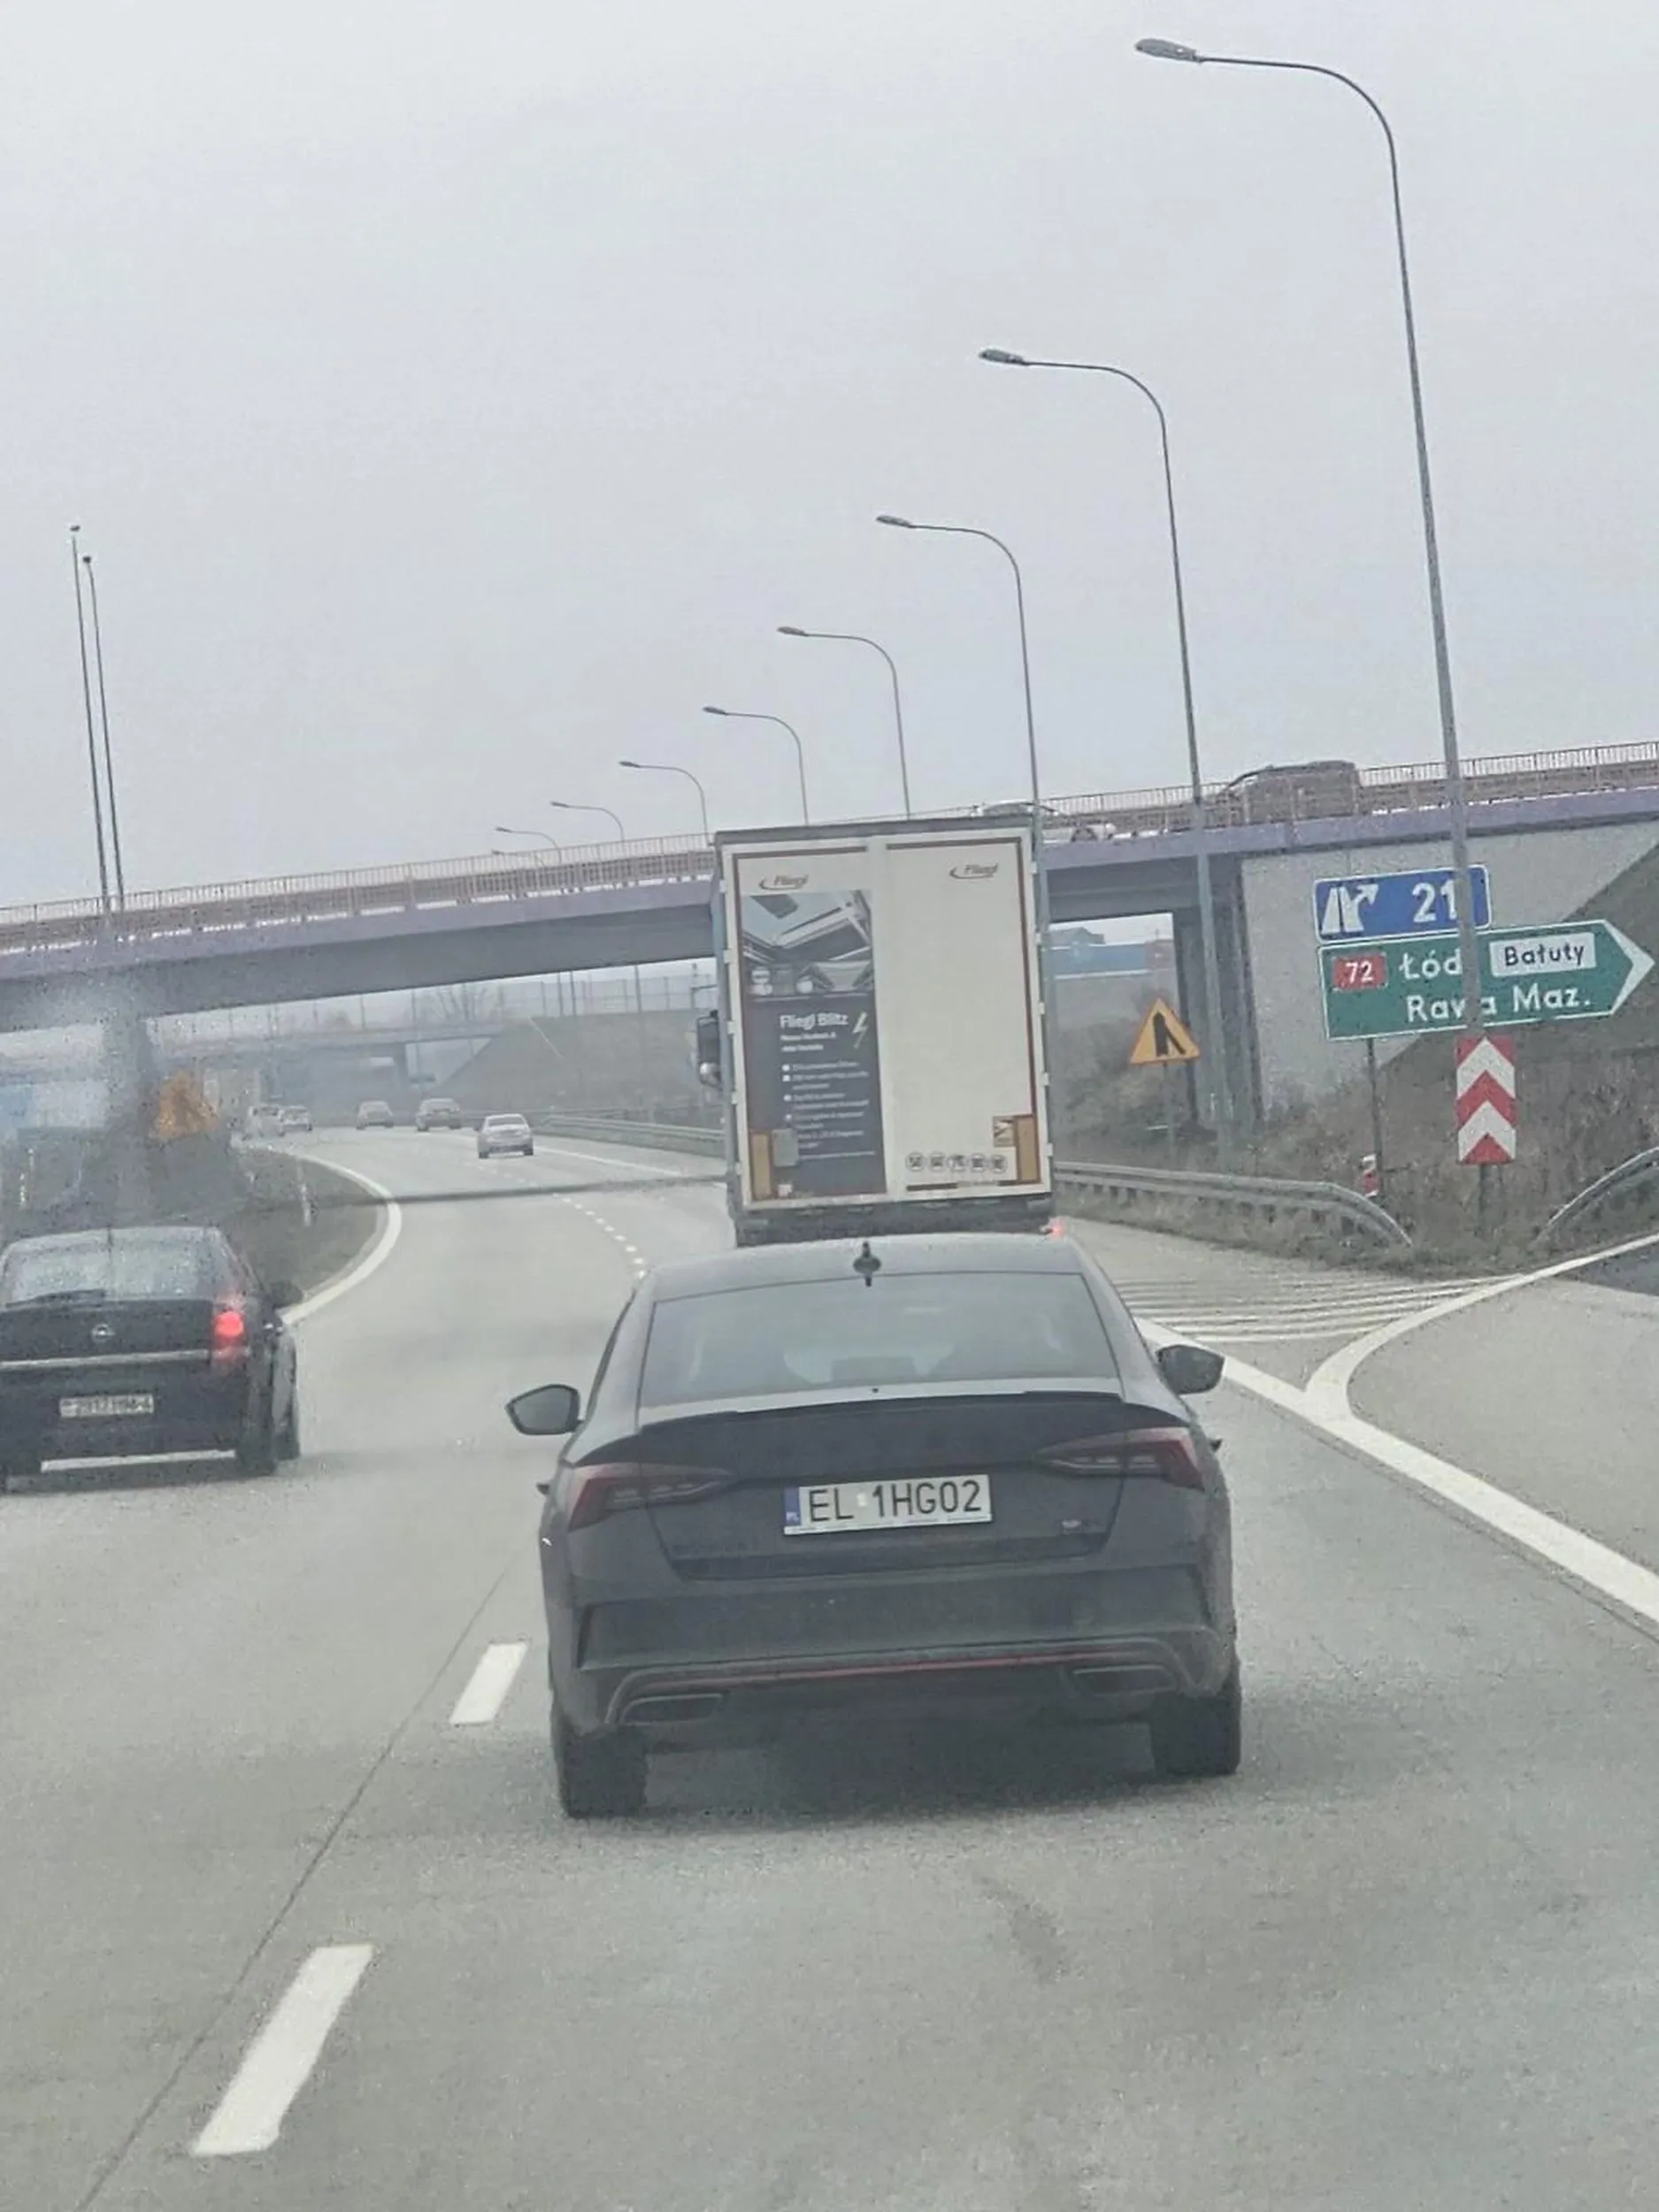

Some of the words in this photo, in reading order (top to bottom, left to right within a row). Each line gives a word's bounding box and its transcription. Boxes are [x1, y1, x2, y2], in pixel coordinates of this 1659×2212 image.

[1412, 879, 1457, 923] 21
[1398, 948, 1463, 979] Łód
[1504, 944, 1586, 967] Bałuty
[1345, 960, 1374, 984] 72
[1512, 982, 1591, 1013] Maz.
[809, 1488, 854, 1522] EL
[872, 1480, 981, 1519] 1HG02
